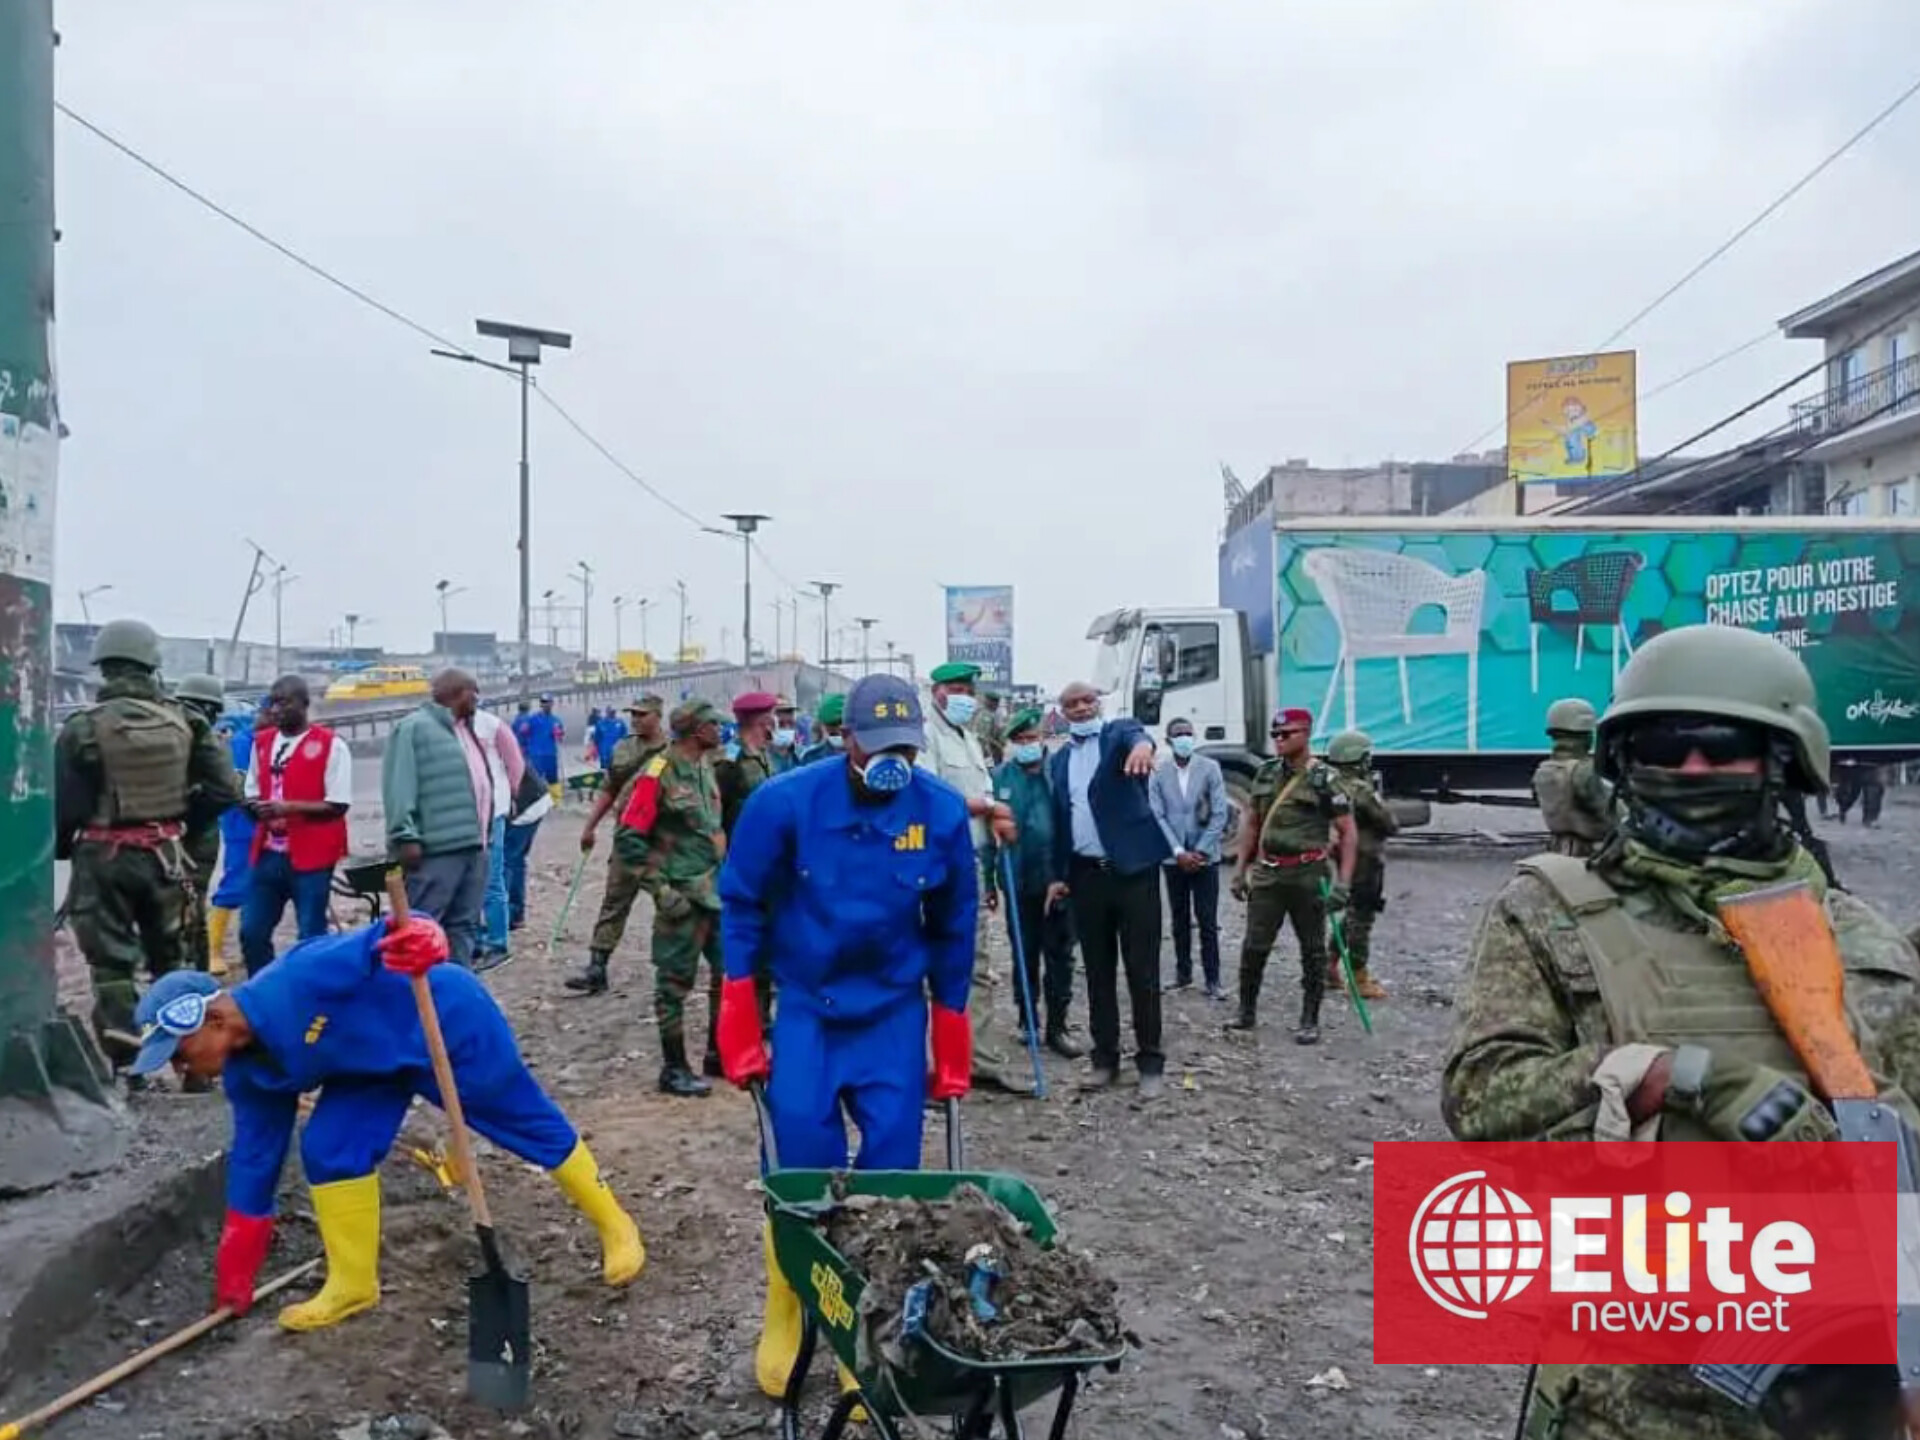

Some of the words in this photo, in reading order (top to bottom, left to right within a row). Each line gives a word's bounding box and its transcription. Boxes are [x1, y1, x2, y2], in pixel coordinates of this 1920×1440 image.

[1706, 569, 1761, 599] OPTEZ
[1767, 564, 1813, 593] POUR
[1818, 556, 1875, 586] VOTRE
[1707, 596, 1770, 626] CHAISE
[1775, 592, 1808, 620] ALU
[1813, 581, 1898, 616] PRESTIGE
